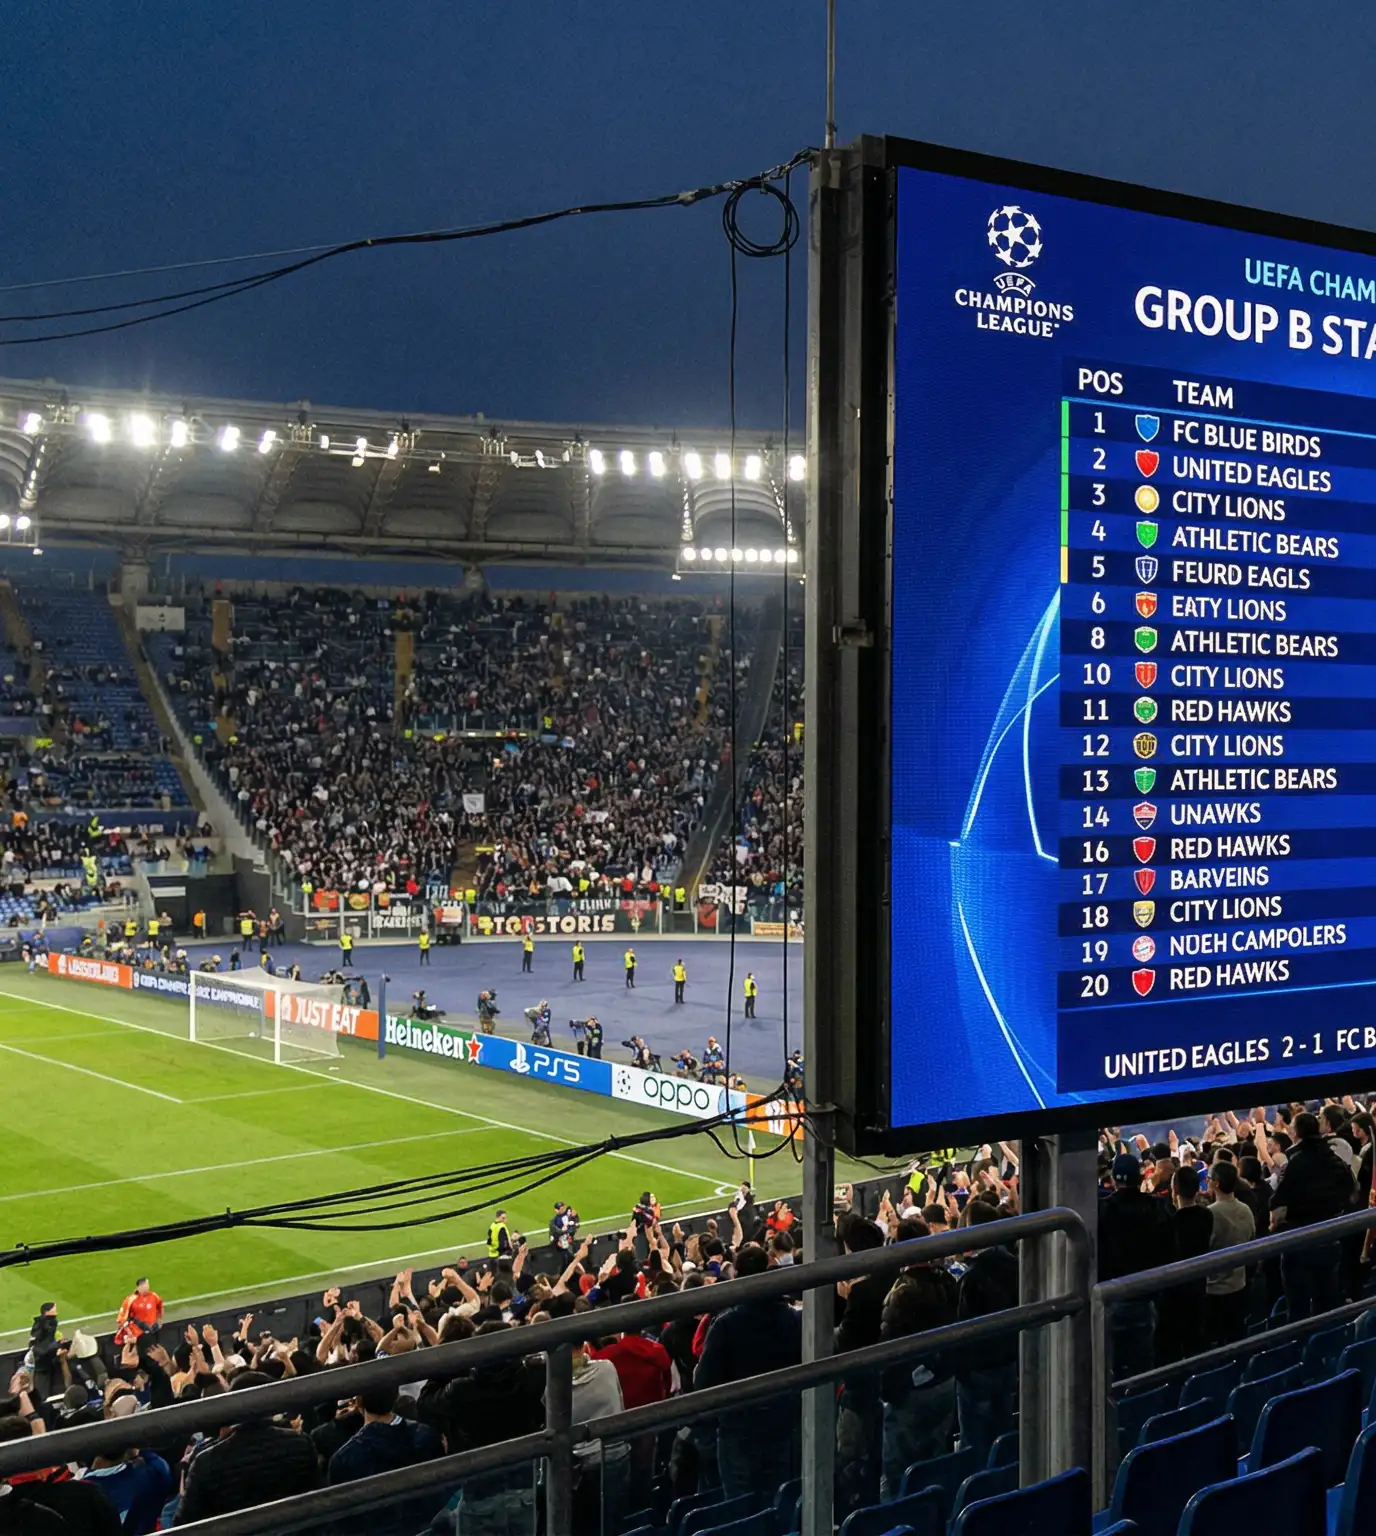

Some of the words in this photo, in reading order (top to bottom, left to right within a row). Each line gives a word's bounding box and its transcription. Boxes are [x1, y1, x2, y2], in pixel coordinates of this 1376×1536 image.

[995, 274, 1033, 294] UEFA
[1246, 258, 1303, 291] UEFA
[955, 288, 1074, 322] CHAMPIONS
[1135, 286, 1278, 343] GROUP
[1289, 310, 1312, 349] B
[977, 312, 1054, 338] LEAGUE
[1079, 368, 1123, 394] POS
[1173, 380, 1233, 409] TEAM
[1095, 412, 1105, 433] 1
[1174, 420, 1198, 443] FC
[1205, 424, 1257, 450] BLUE
[1263, 431, 1320, 457] BIRDS
[1093, 448, 1106, 469] 2
[1174, 456, 1252, 483] UNITED
[1257, 465, 1331, 492] EAGLES
[1093, 484, 1105, 505] 3
[1173, 491, 1220, 515] CITY
[1226, 496, 1285, 520] LIONS
[1092, 520, 1106, 541] 4
[1172, 526, 1271, 553] ATHLETIC
[1277, 534, 1338, 558] BEARS
[1092, 556, 1105, 577] 5
[1173, 561, 1242, 585] FEURD
[1248, 566, 1310, 589] EAGLS
[1092, 592, 1105, 613] 6
[1173, 596, 1222, 618] EATY
[1228, 599, 1286, 621] LIONS
[1091, 627, 1104, 649] 8
[1171, 631, 1270, 654] ATHLETIC
[1276, 635, 1338, 657] BEARS
[1084, 663, 1110, 685] 10
[1171, 665, 1219, 687] CITY
[1225, 667, 1284, 689] LIONS
[1084, 699, 1108, 720] 11
[1172, 700, 1213, 721] RED
[1219, 701, 1291, 722] HAWKS
[1084, 734, 1109, 756] 12
[1171, 735, 1218, 756] CITY
[1225, 735, 1283, 756] LIONS
[1084, 770, 1108, 791] 13
[1171, 769, 1269, 790] ATHLETIC
[1275, 768, 1337, 789] BEARS
[1083, 806, 1109, 827] 14
[1171, 803, 1261, 825] UNAWKS
[1083, 841, 1109, 862] 16
[1171, 838, 1212, 859] RED
[1218, 835, 1290, 857] HAWKS
[1083, 874, 1108, 894] 17
[1171, 866, 1268, 890] BARVEINS
[1083, 906, 1108, 928] 18
[1170, 900, 1217, 922] CITY
[1223, 896, 1281, 919] LIONS
[1083, 941, 1108, 962] 19
[1232, 924, 1346, 951] CAMPOLERS
[1081, 975, 1108, 997] 20
[1171, 967, 1211, 989] RED
[1217, 960, 1289, 986] HAWKS
[295, 995, 332, 1028] JUST
[331, 1002, 360, 1036] EAT
[385, 1014, 465, 1060] Heineken
[1105, 1048, 1186, 1078] UNITED
[1192, 1039, 1269, 1068] EAGLES
[1283, 1036, 1293, 1057] 2
[1314, 1033, 1323, 1054] 1
[1337, 1028, 1359, 1051] FC
[533, 1052, 581, 1083] PS5
[643, 1076, 710, 1110] oppo
